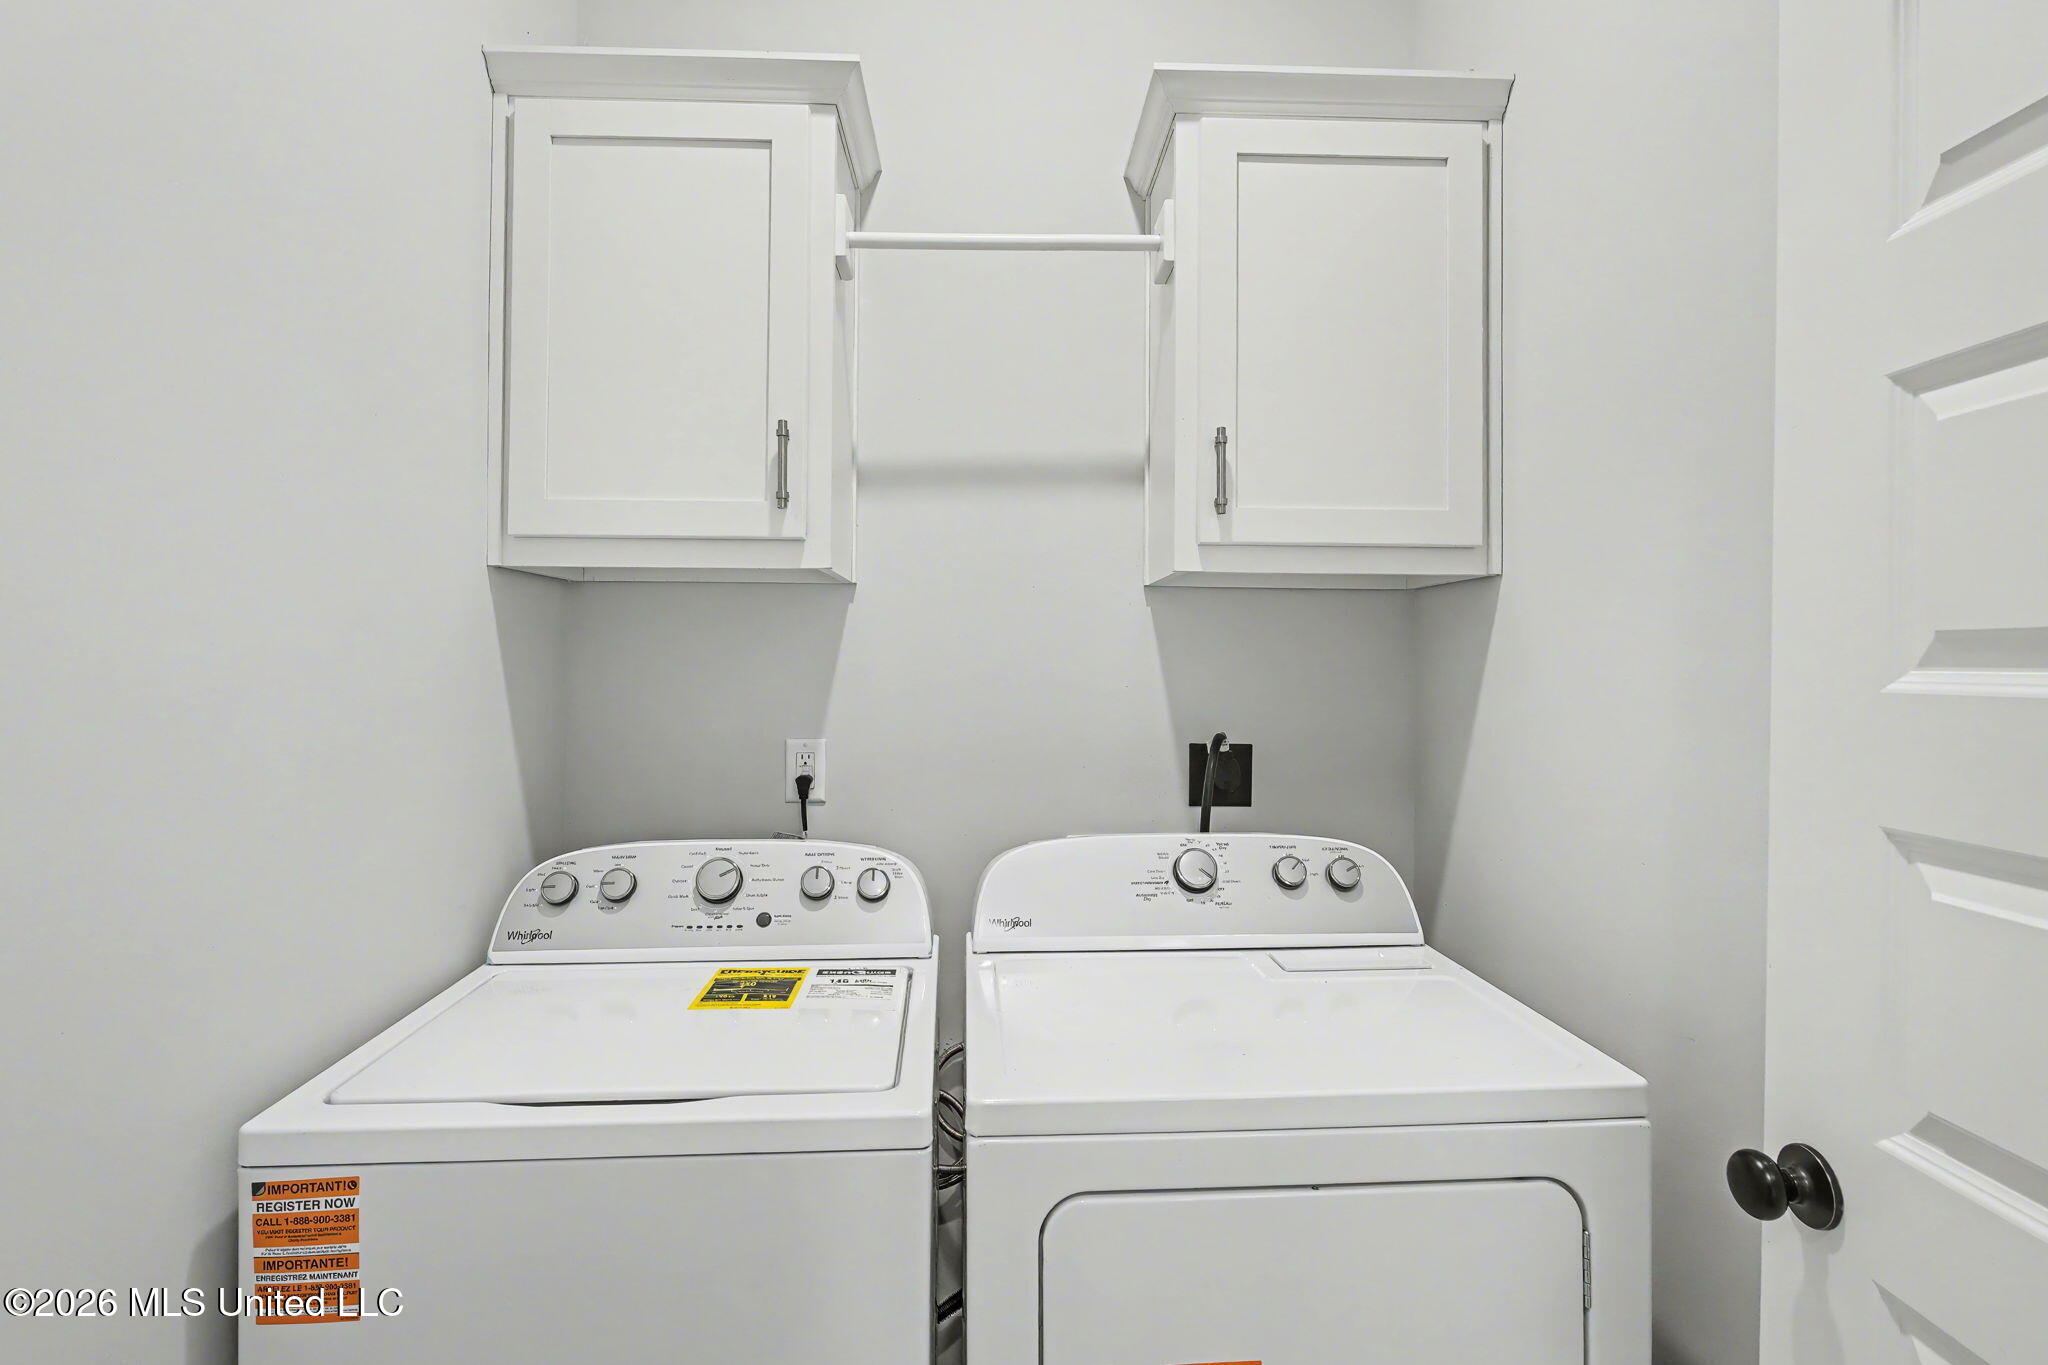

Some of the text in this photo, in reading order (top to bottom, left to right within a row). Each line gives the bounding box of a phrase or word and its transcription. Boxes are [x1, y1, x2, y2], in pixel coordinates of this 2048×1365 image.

[988, 916, 1032, 932] Whirlpool
[507, 928, 553, 945] Whirlpool
[267, 1180, 347, 1196] IMPORTANT!
[256, 1197, 356, 1213] REGISTER NOW
[255, 1218, 282, 1228] CALL
[262, 1256, 349, 1271] IMPORTANTE!
[255, 1271, 358, 1283] ENREGISTREZ MAINTENANT
